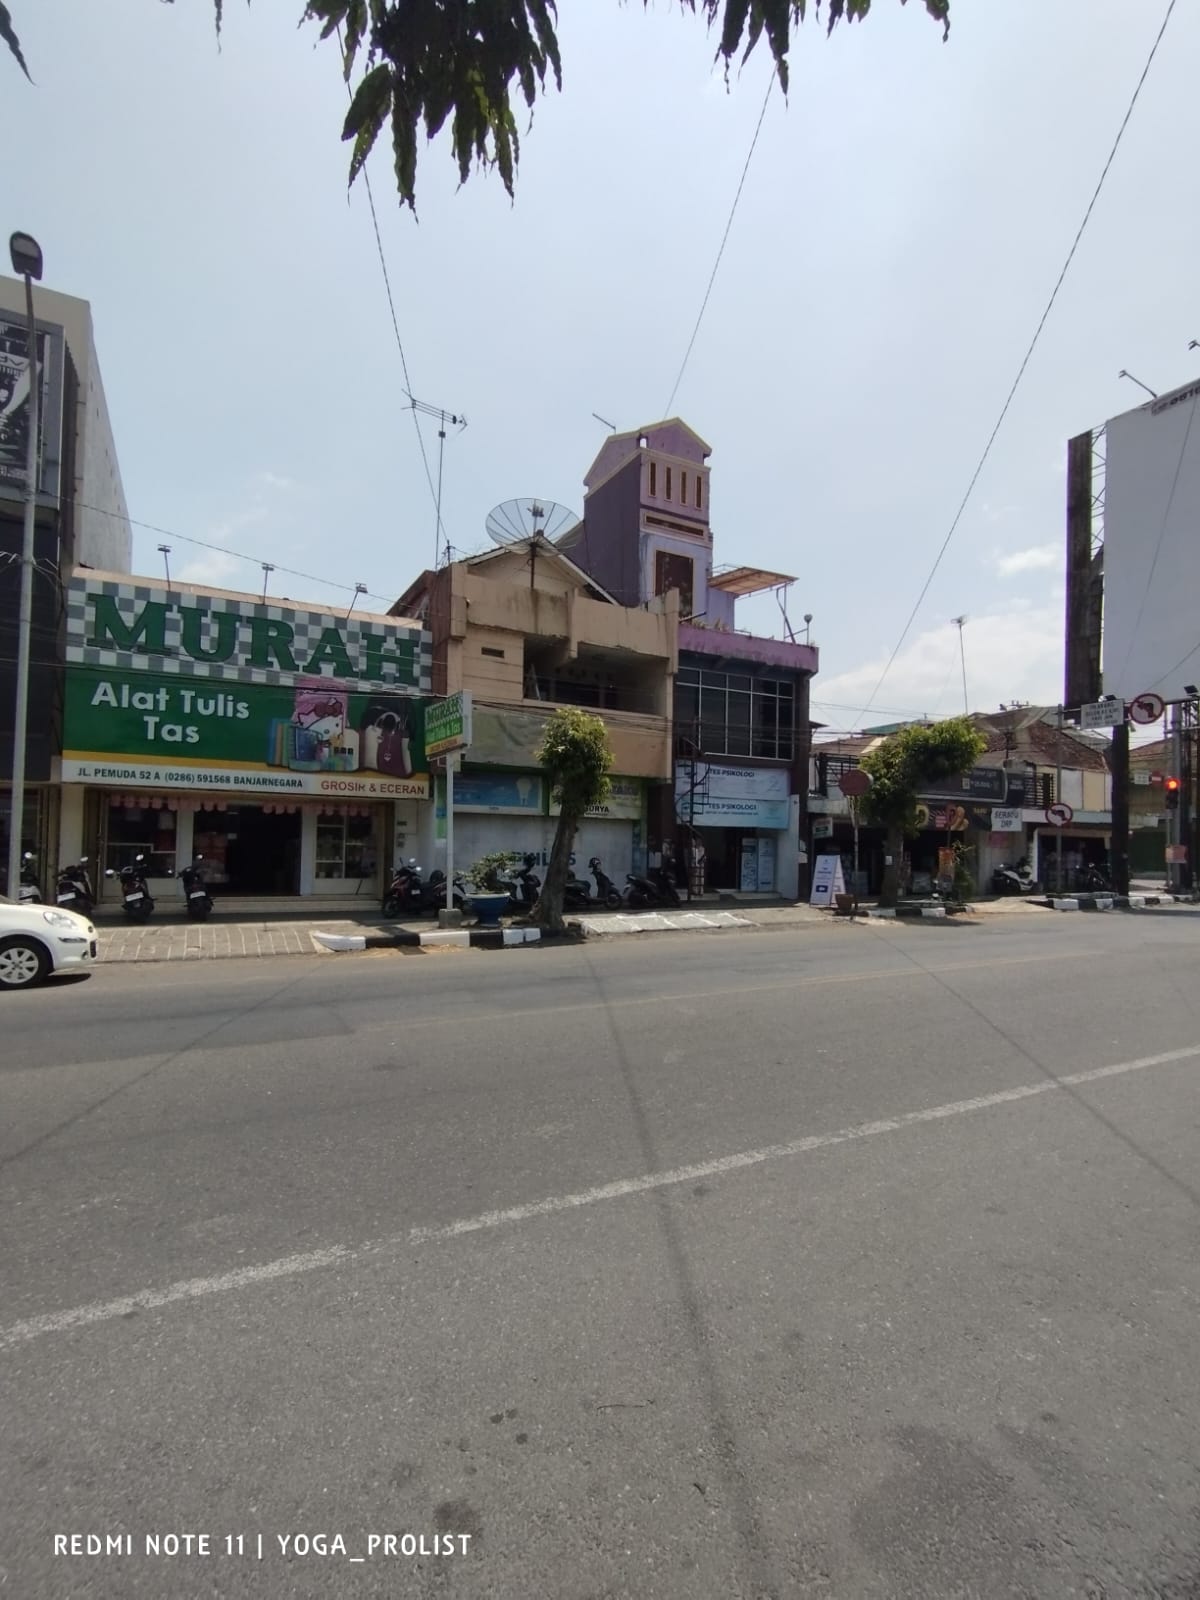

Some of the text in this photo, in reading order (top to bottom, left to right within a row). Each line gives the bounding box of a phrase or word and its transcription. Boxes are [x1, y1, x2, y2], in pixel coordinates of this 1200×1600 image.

[86, 592, 422, 687] MURAH
[91, 681, 250, 719] Alat Tulis
[143, 715, 200, 743] Tas
[77, 767, 303, 788] JL. PEMUDA 52 A (0286) 591568 BANJARNEGARA
[368, 782, 377, 793] &
[380, 783, 425, 795] ECERAN
